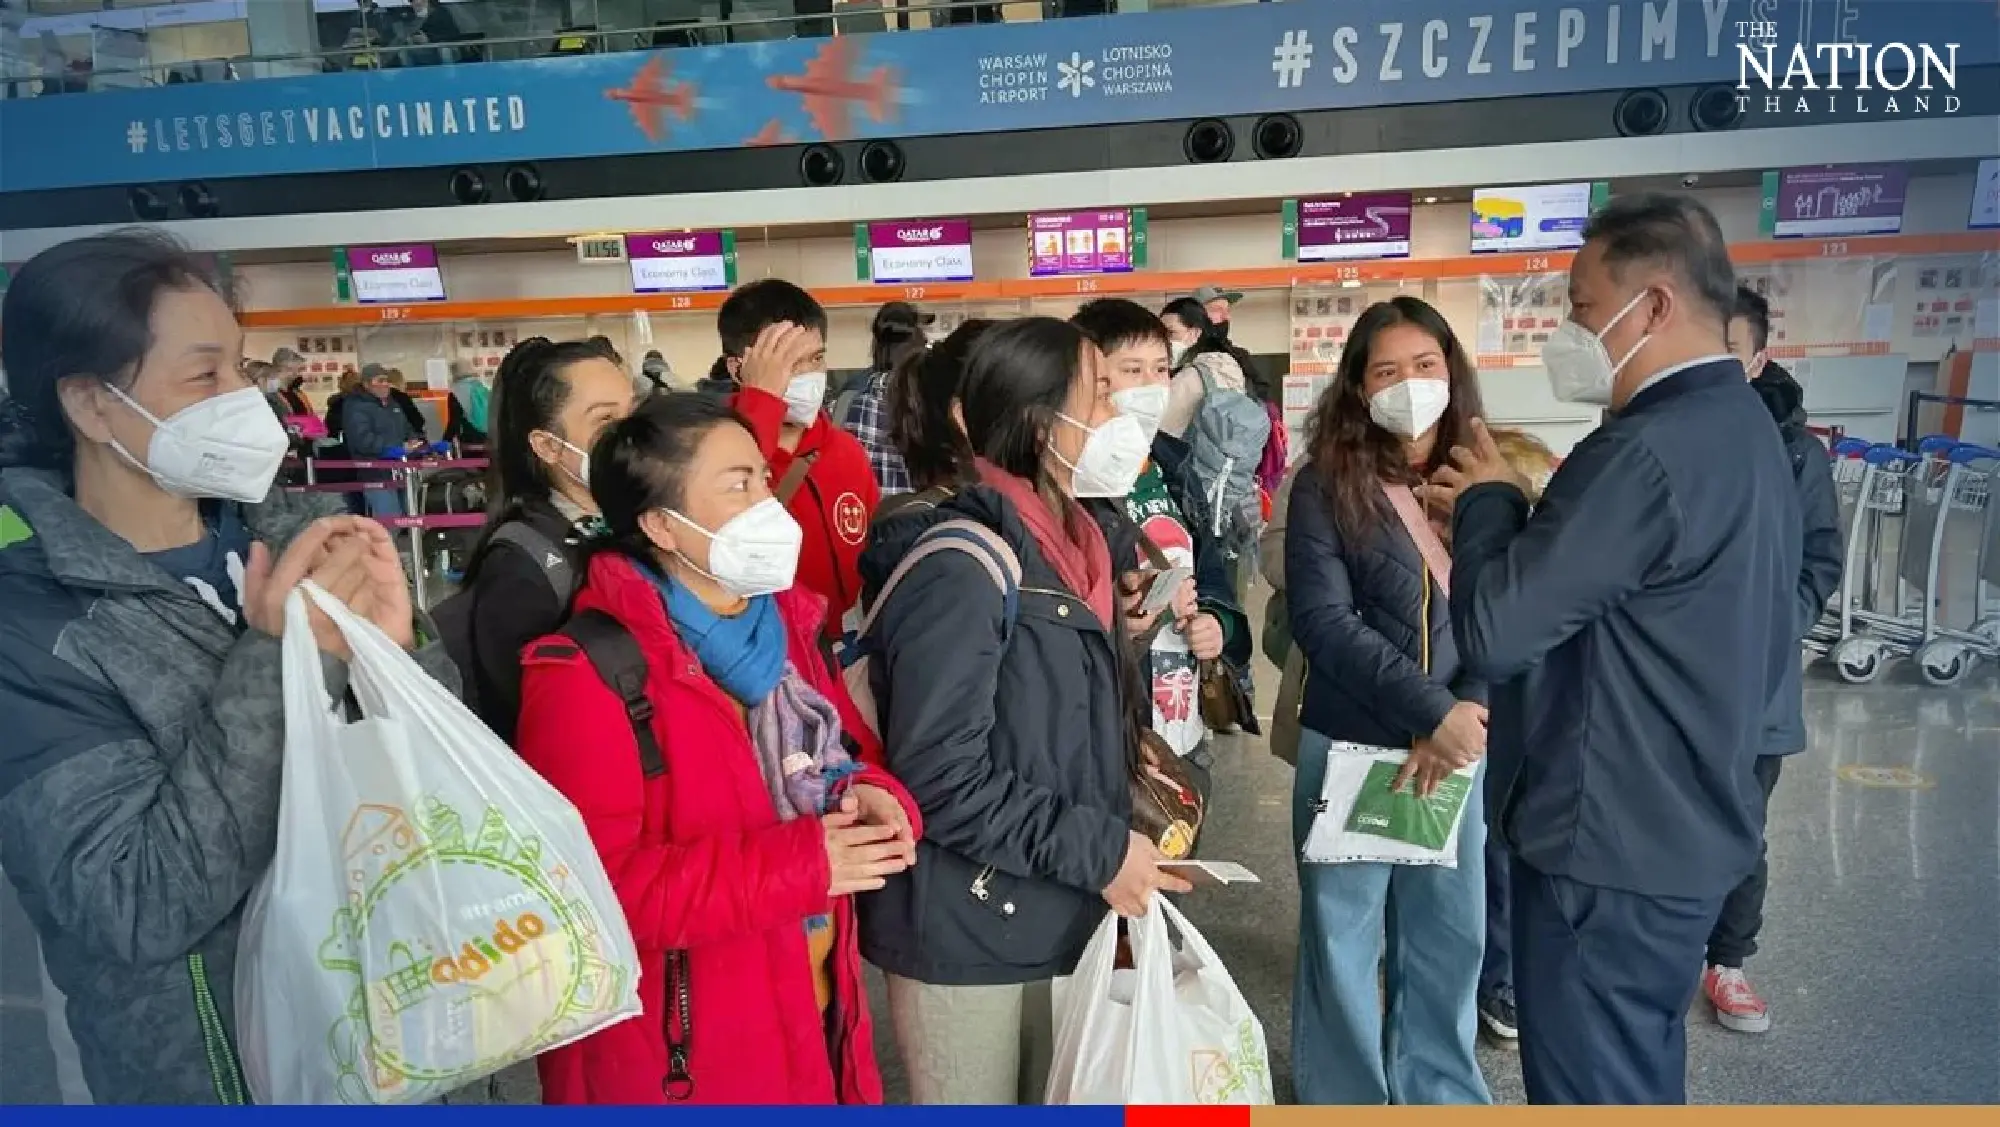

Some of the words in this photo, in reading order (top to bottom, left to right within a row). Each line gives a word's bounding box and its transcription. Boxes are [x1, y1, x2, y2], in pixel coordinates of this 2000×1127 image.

[1102, 44, 1173, 63] LOTNISKO
[978, 53, 1048, 71] WARSAW
[1102, 62, 1173, 81] CHOPINA
[979, 71, 1048, 88] CHOPIN
[979, 86, 1048, 103] AIRPORT
[1102, 80, 1173, 96] WARSZAWA
[127, 95, 525, 154] #LETSGETVACCINATED
[897, 227, 929, 239] QATAR
[652, 240, 685, 249] QATAR
[1822, 243, 1848, 256] 123
[1525, 258, 1549, 271] 124
[1336, 266, 1359, 279] 125
[904, 287, 926, 299] 127
[1076, 279, 1098, 293] 126
[671, 297, 691, 308] 128
